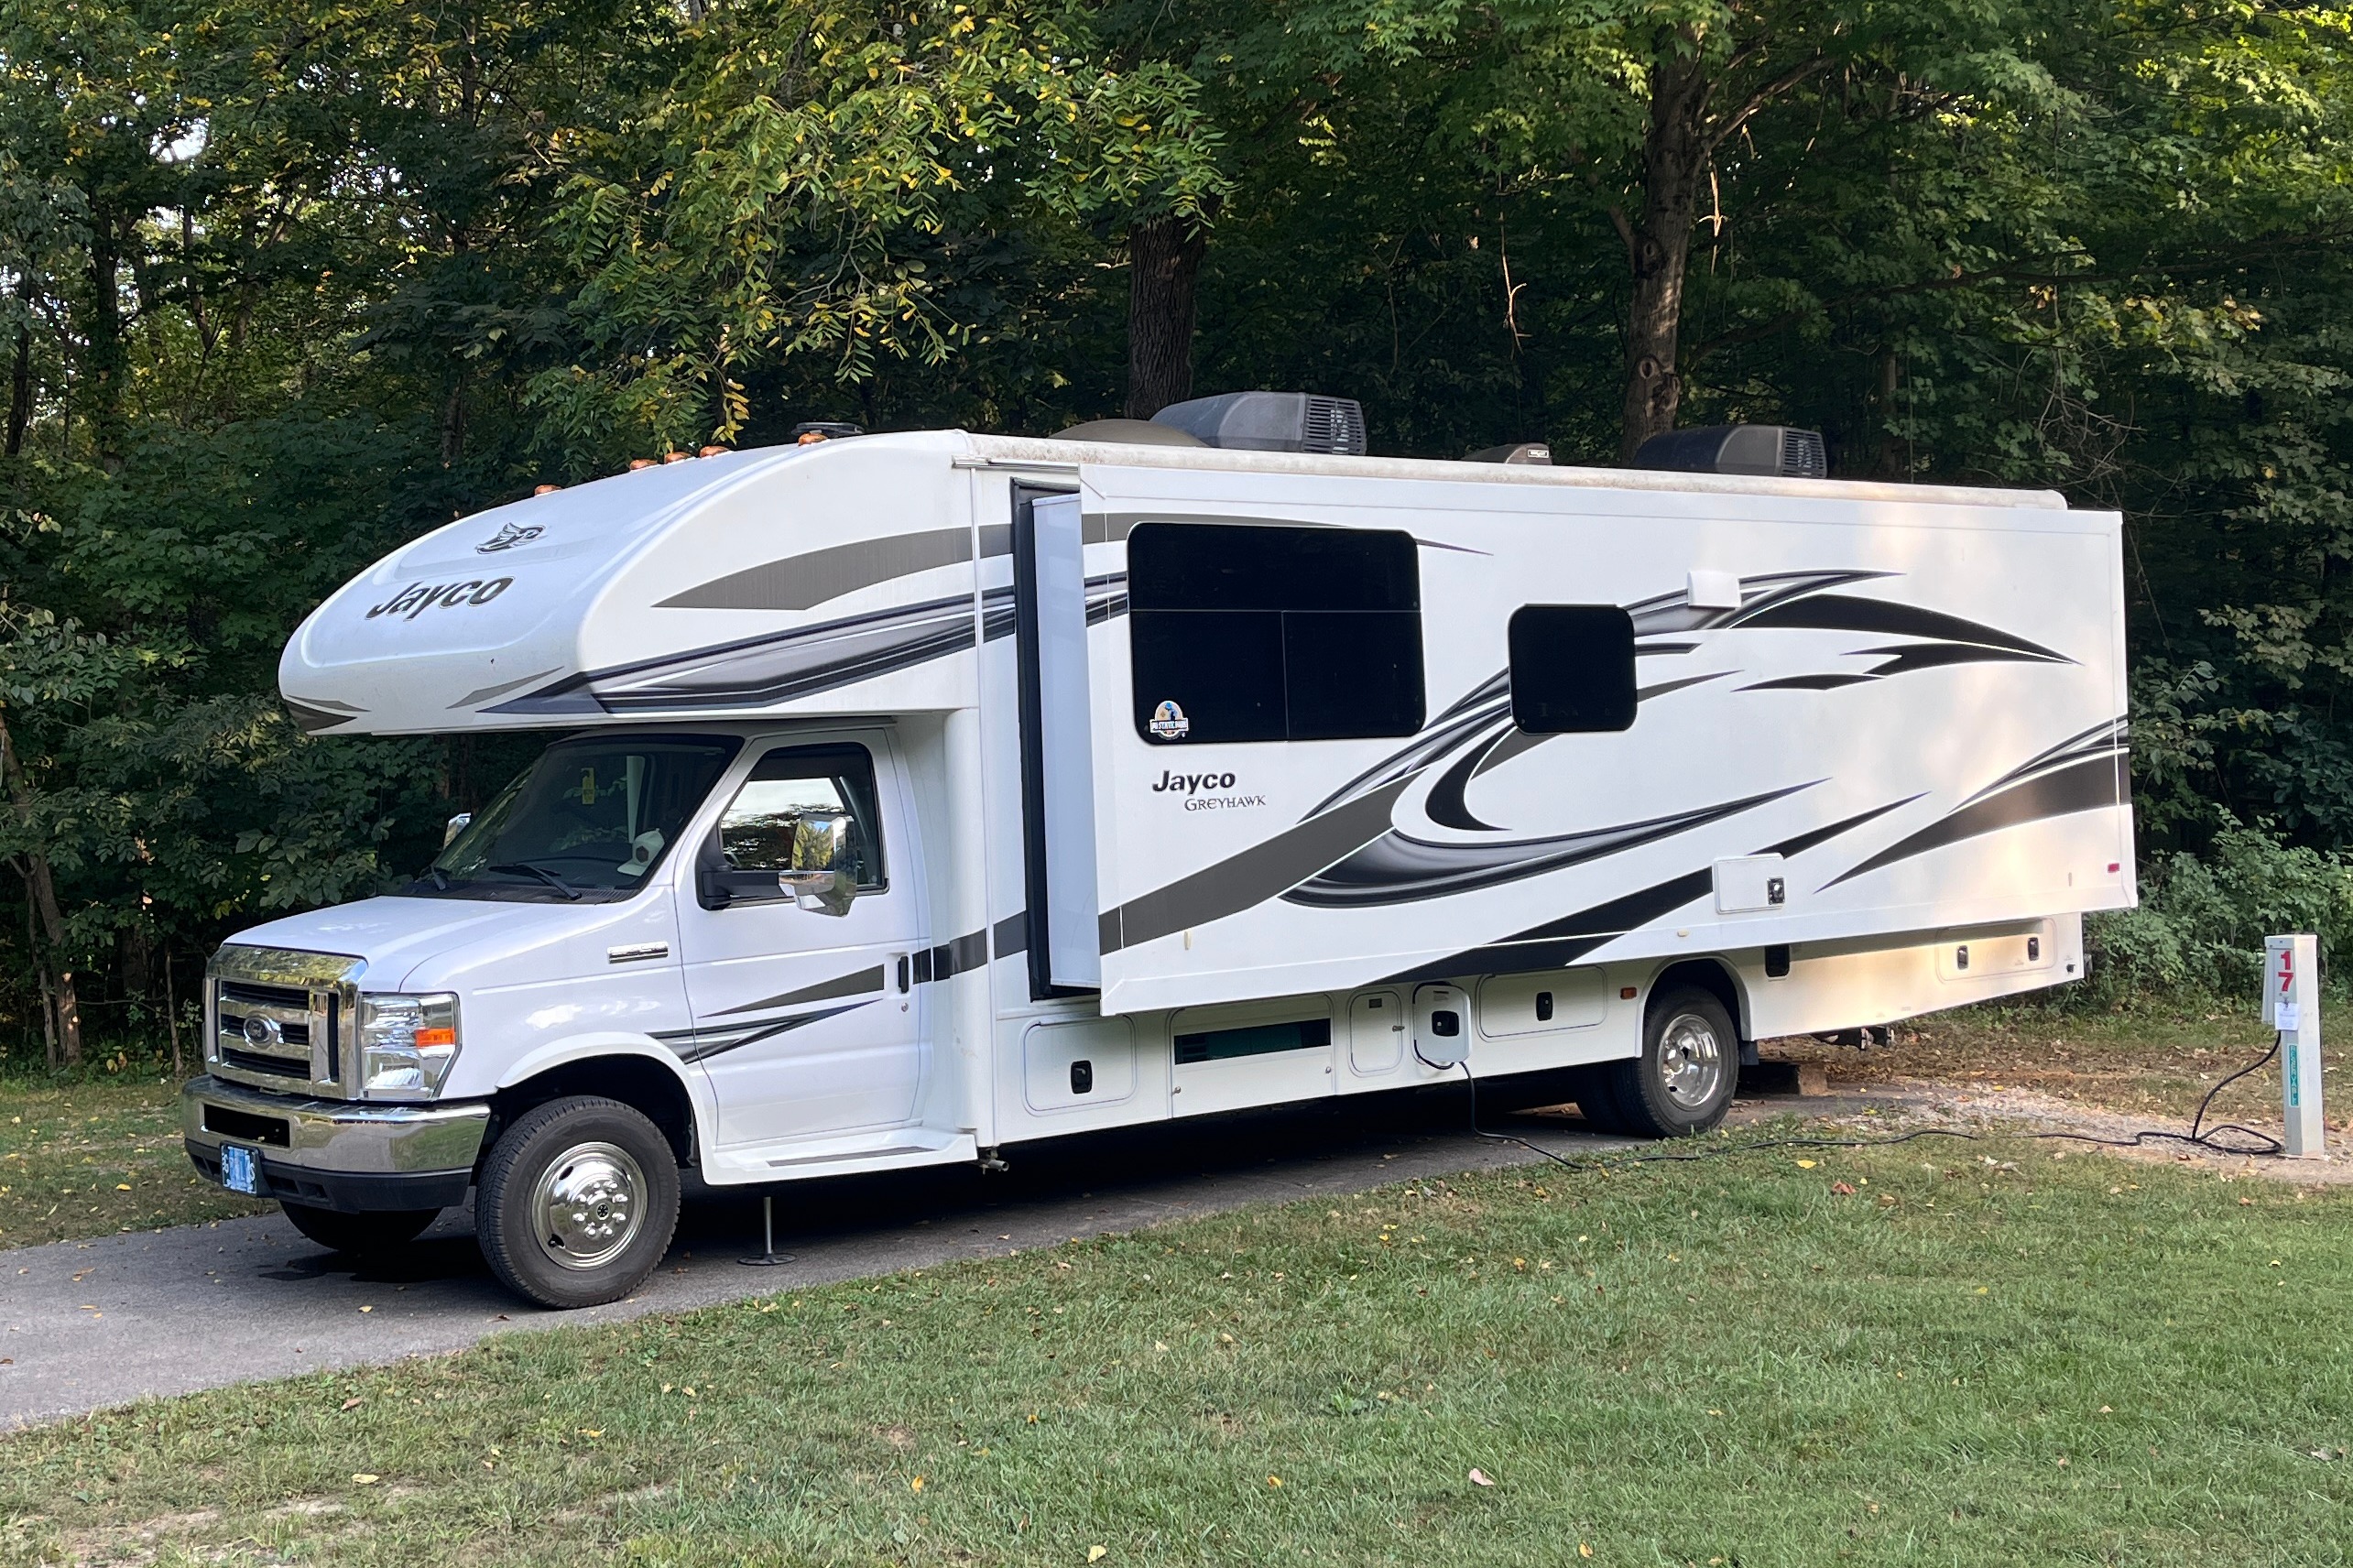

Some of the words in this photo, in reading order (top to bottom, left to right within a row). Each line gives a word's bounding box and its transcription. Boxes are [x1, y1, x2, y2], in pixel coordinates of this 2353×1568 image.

[365, 576, 515, 622] Jayco
[1152, 770, 1236, 795] Jayco
[1184, 795, 1266, 811] GREYHAWK
